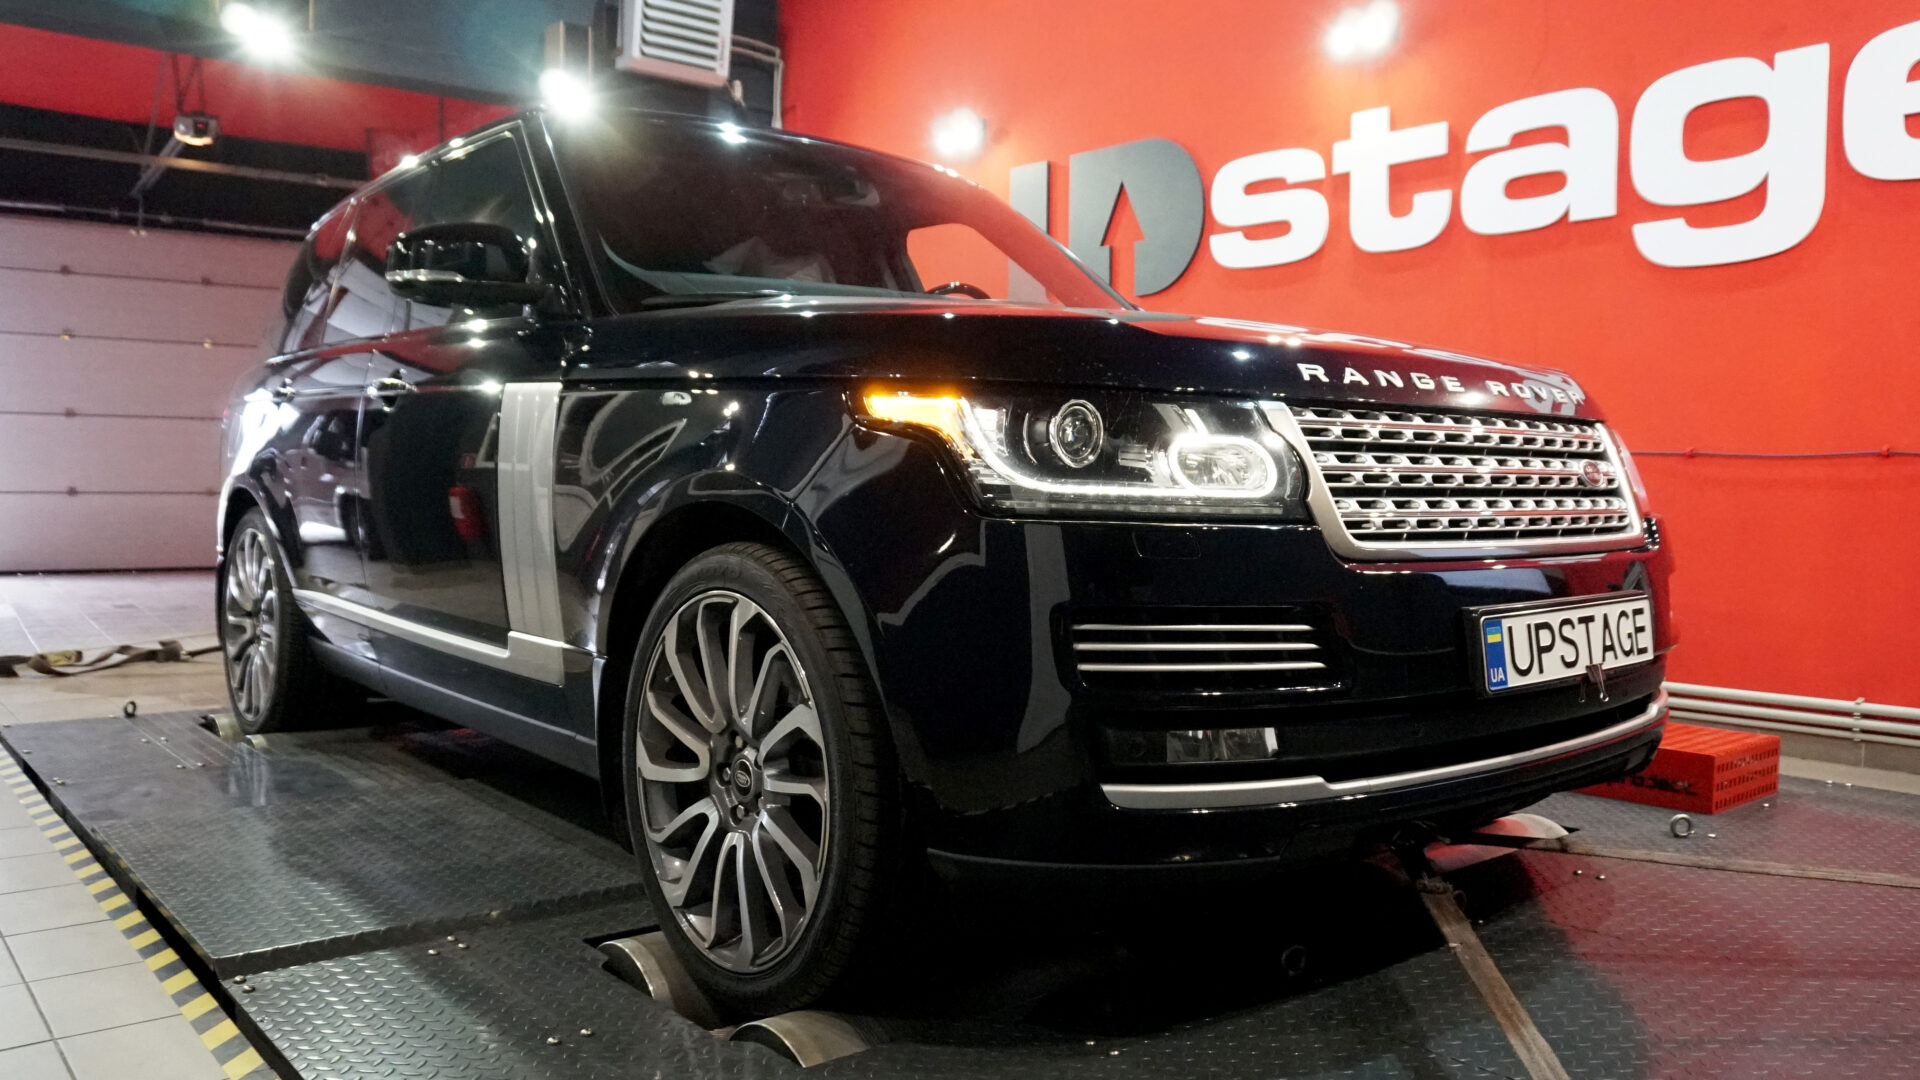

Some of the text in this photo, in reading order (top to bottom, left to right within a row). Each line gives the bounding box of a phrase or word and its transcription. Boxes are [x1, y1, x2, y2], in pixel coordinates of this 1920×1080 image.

[1297, 363, 1585, 405] RANGE ROVER
[1490, 608, 1649, 683] UA UPSTAGE
